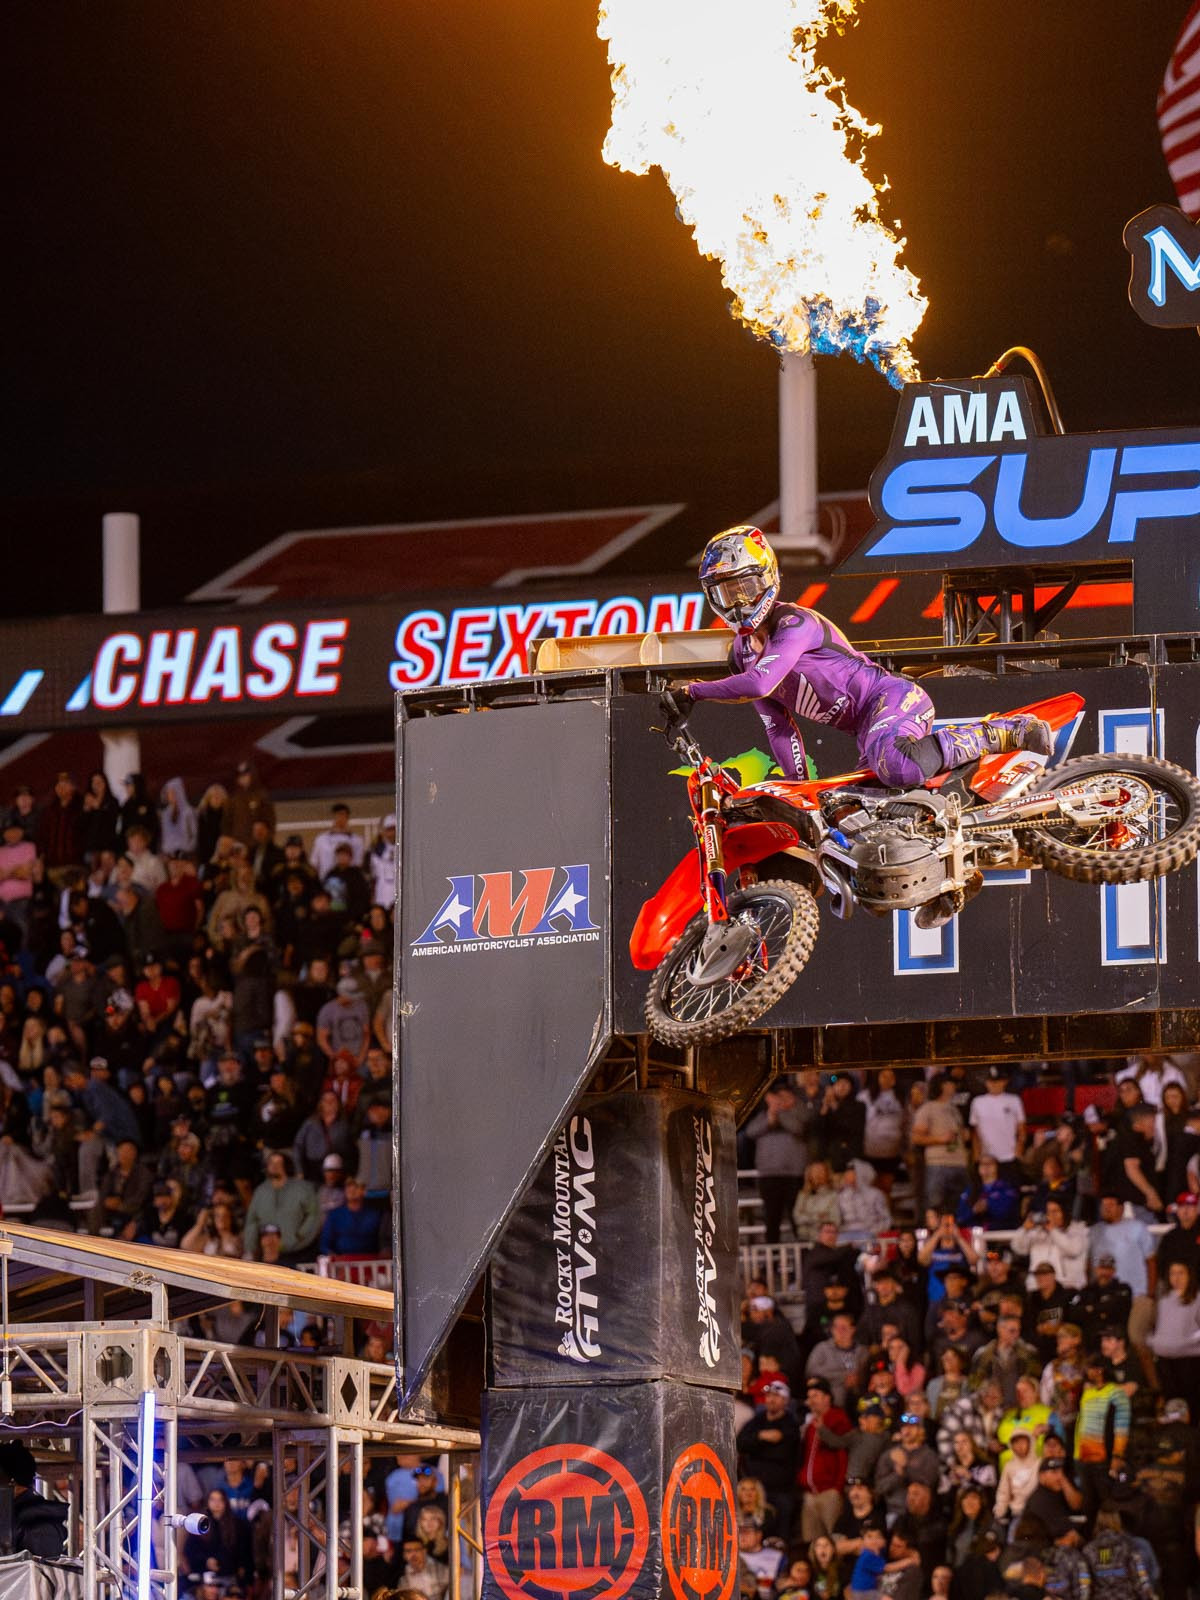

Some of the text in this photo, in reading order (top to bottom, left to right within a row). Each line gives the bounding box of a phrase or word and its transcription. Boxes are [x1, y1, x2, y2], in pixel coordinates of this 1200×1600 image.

[904, 390, 1027, 447] AMA
[92, 618, 349, 710] CHASE
[410, 864, 601, 945] AMA
[412, 932, 600, 957] AMERICAN MOTORCYCLIST ASSOCIATION
[553, 1127, 574, 1327] ROCKY MOUNTA
[695, 1246, 709, 1327] ROCKY
[515, 1496, 616, 1571] RM
[678, 1495, 724, 1571] RM
